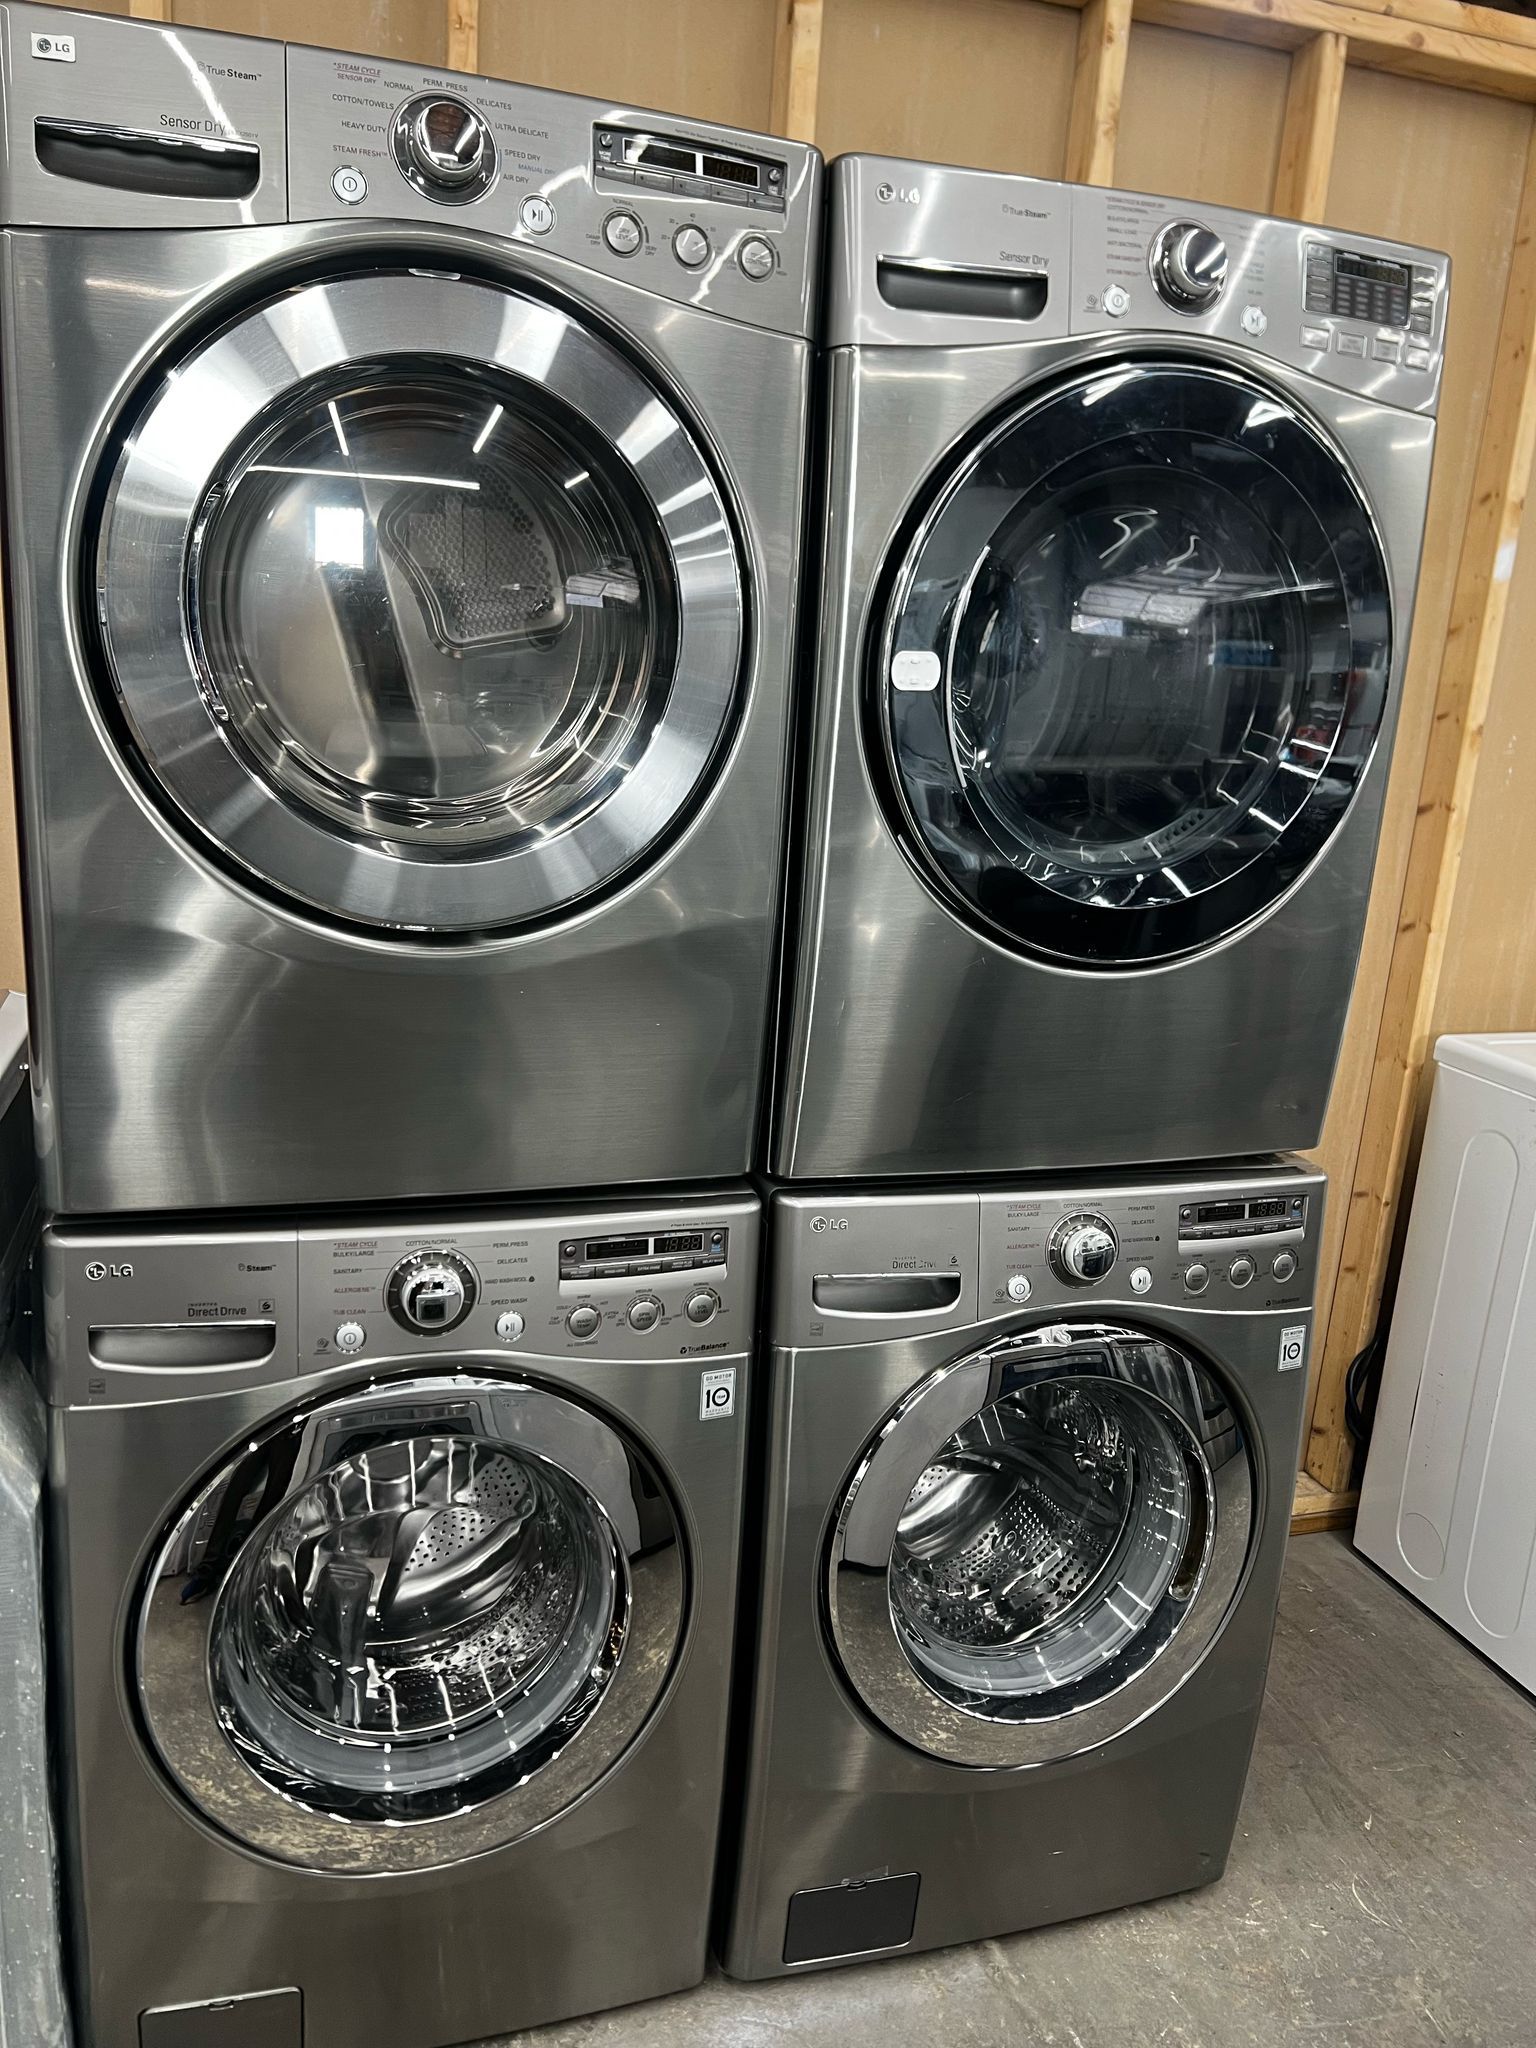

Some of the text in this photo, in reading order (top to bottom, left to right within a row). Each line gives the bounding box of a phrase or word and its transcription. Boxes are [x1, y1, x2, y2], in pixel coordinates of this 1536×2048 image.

[55, 42, 70, 53] LG
[337, 73, 362, 82] SENSOR
[361, 66, 381, 76] CYCLE
[384, 81, 415, 92] NORMAL
[423, 78, 468, 92] PERM. PRESS
[332, 94, 395, 110] COTTON/TOWELS
[476, 98, 512, 111] DELICATES
[160, 114, 202, 130] Sensor
[204, 120, 226, 136] Dry
[341, 120, 387, 133] HEAVY DUTY
[494, 122, 549, 140] ULTRA DELICATE
[333, 145, 358, 154] STEAM
[504, 149, 526, 159] SPEED
[999, 251, 1049, 268] Sensor Dry
[830, 1219, 848, 1230] LG
[110, 1264, 133, 1277] LG
[892, 1261, 916, 1269] Direct
[188, 1306, 247, 1317] Direct Drive
[1283, 1343, 1300, 1361] 10
[706, 1387, 730, 1408] 10
